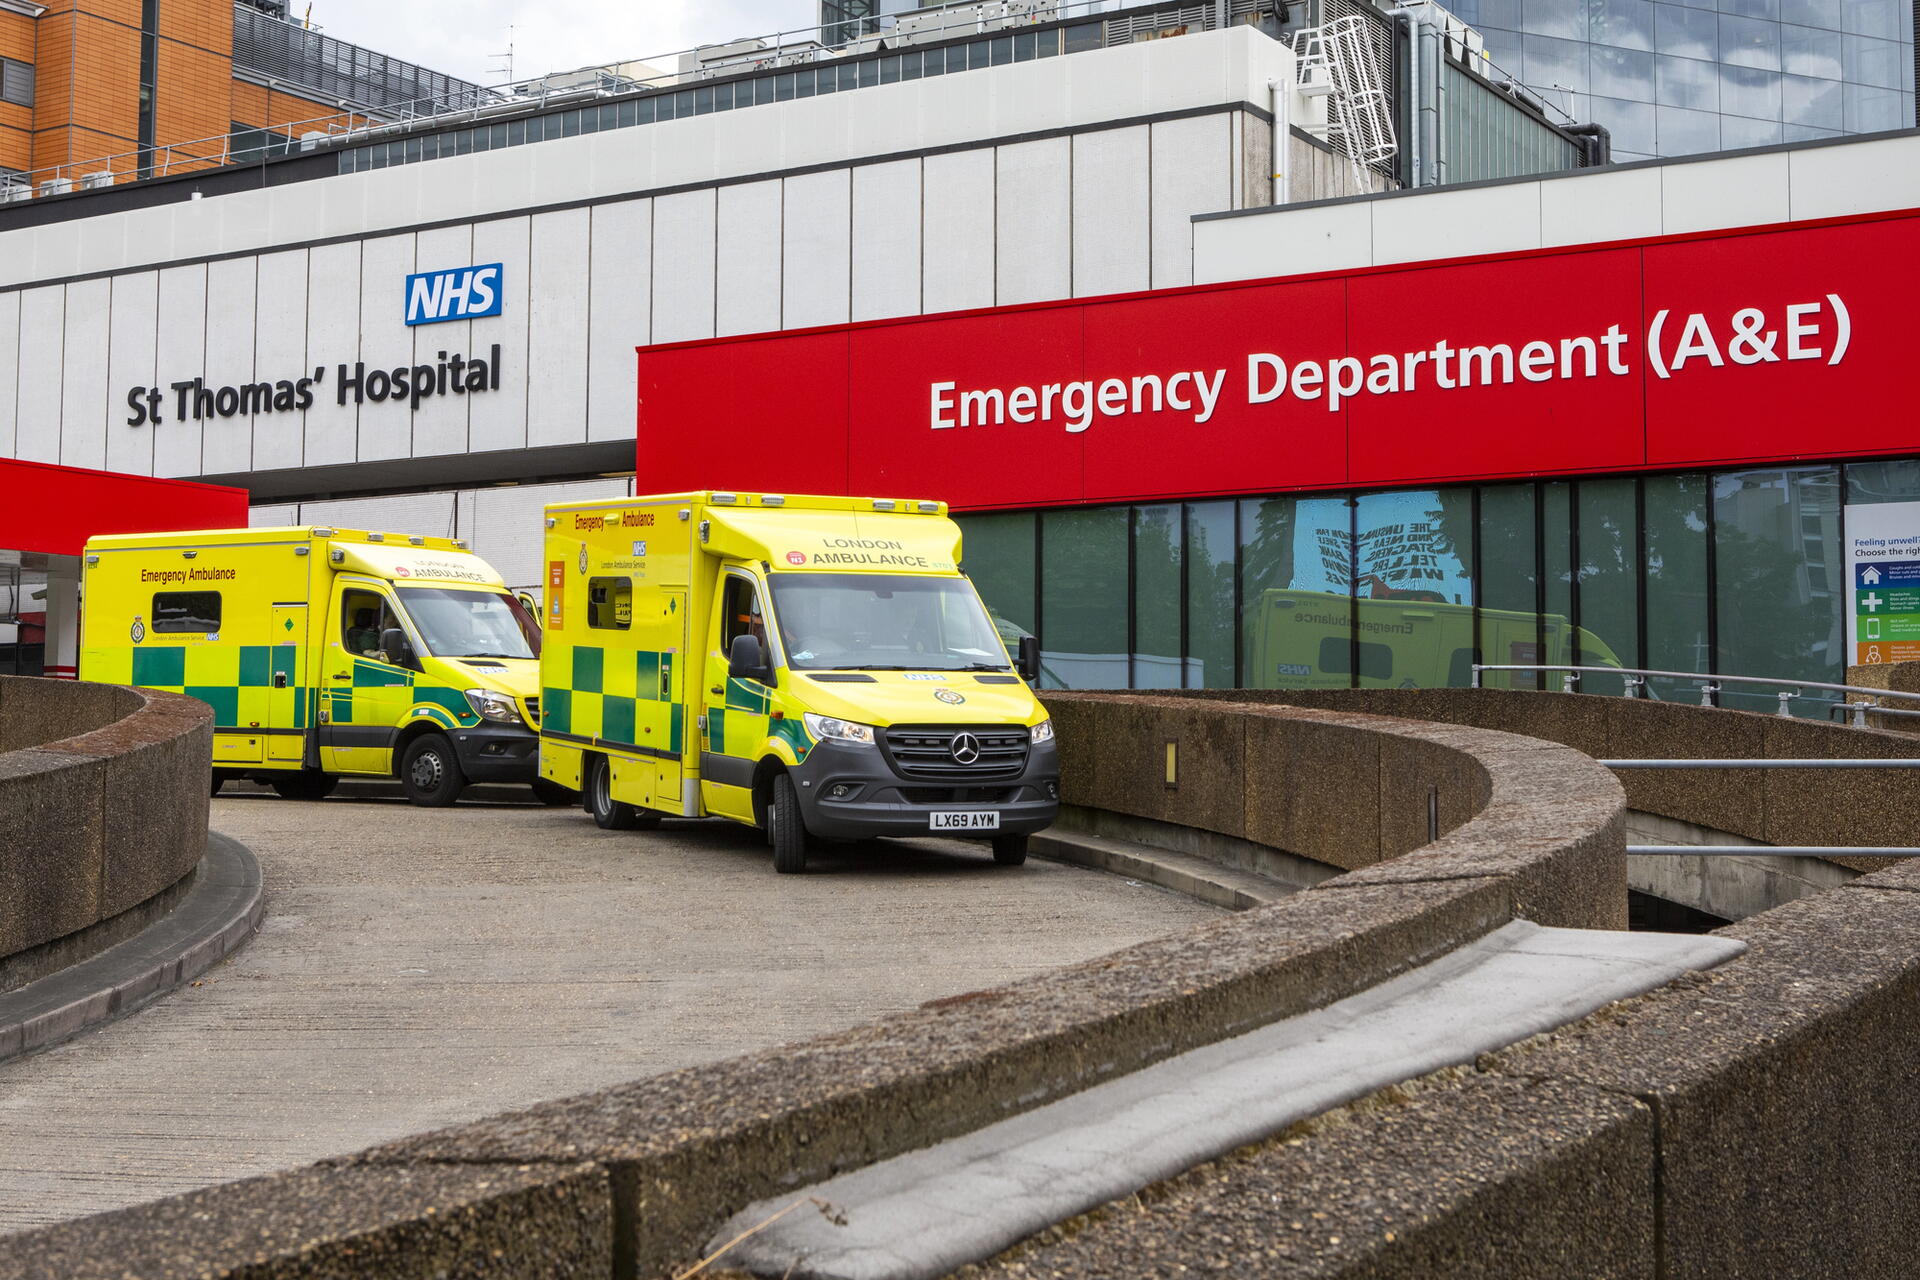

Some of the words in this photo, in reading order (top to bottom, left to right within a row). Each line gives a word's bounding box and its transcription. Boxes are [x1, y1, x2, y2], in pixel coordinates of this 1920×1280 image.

[407, 267, 497, 321] NHS
[930, 368, 1227, 433] Emergency
[1247, 323, 1629, 412] Department
[1647, 293, 1851, 379] (A&E)
[127, 386, 163, 427] St
[338, 343, 501, 410] Hospital
[575, 513, 605, 532] Emergency
[622, 510, 655, 528] Ambulance
[632, 541, 646, 556] NHS
[822, 538, 903, 550] LONDON
[1854, 538, 1885, 547] Feeling
[1889, 547, 1904, 555] the
[813, 553, 929, 568] AMBULANCE
[141, 569, 187, 585] Emergency
[188, 567, 236, 581] Ambulance
[414, 568, 487, 583] AMBULANCE
[206, 633, 219, 641] NHS
[935, 814, 968, 827] LX69
[971, 814, 995, 827] AYM
